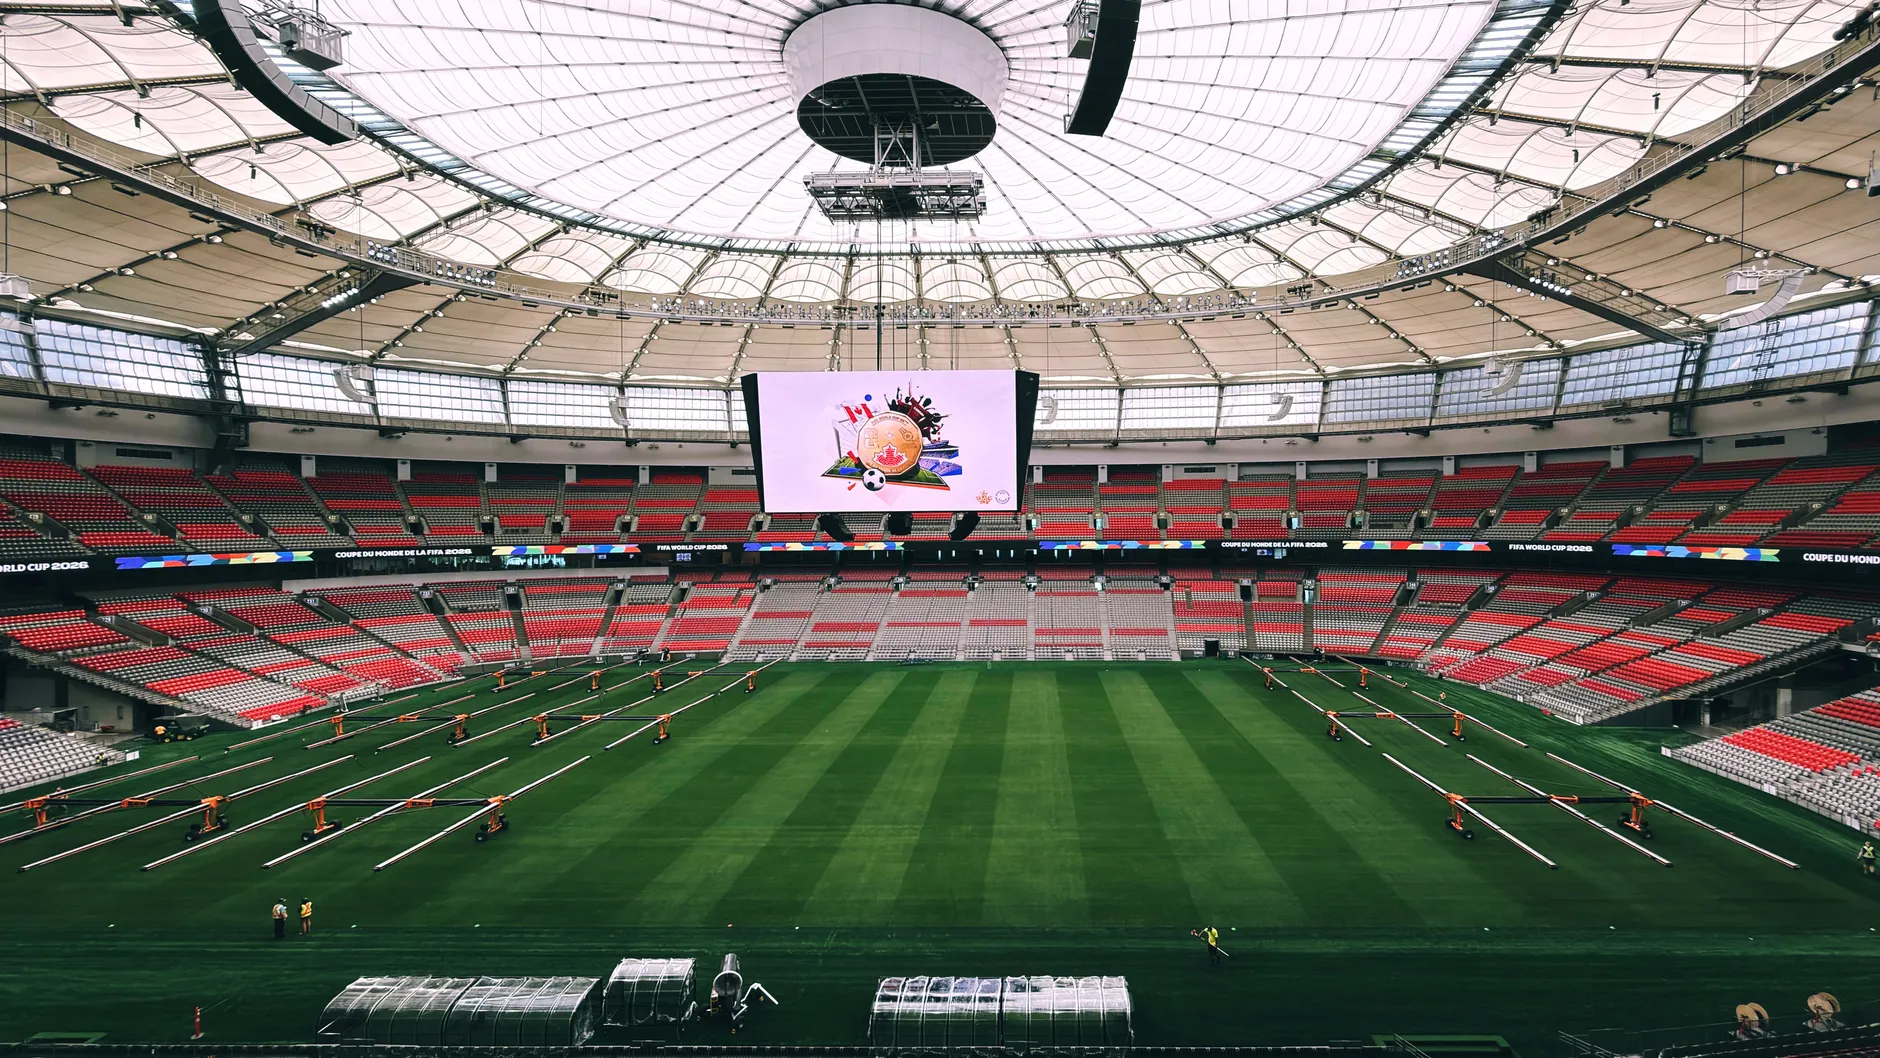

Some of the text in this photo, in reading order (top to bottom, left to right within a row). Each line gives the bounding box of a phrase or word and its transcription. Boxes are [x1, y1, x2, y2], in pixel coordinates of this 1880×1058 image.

[1803, 553, 1834, 562] COUPE
[1834, 554, 1849, 562] DU
[27, 563, 50, 571] CUP
[51, 561, 89, 570] 2026
